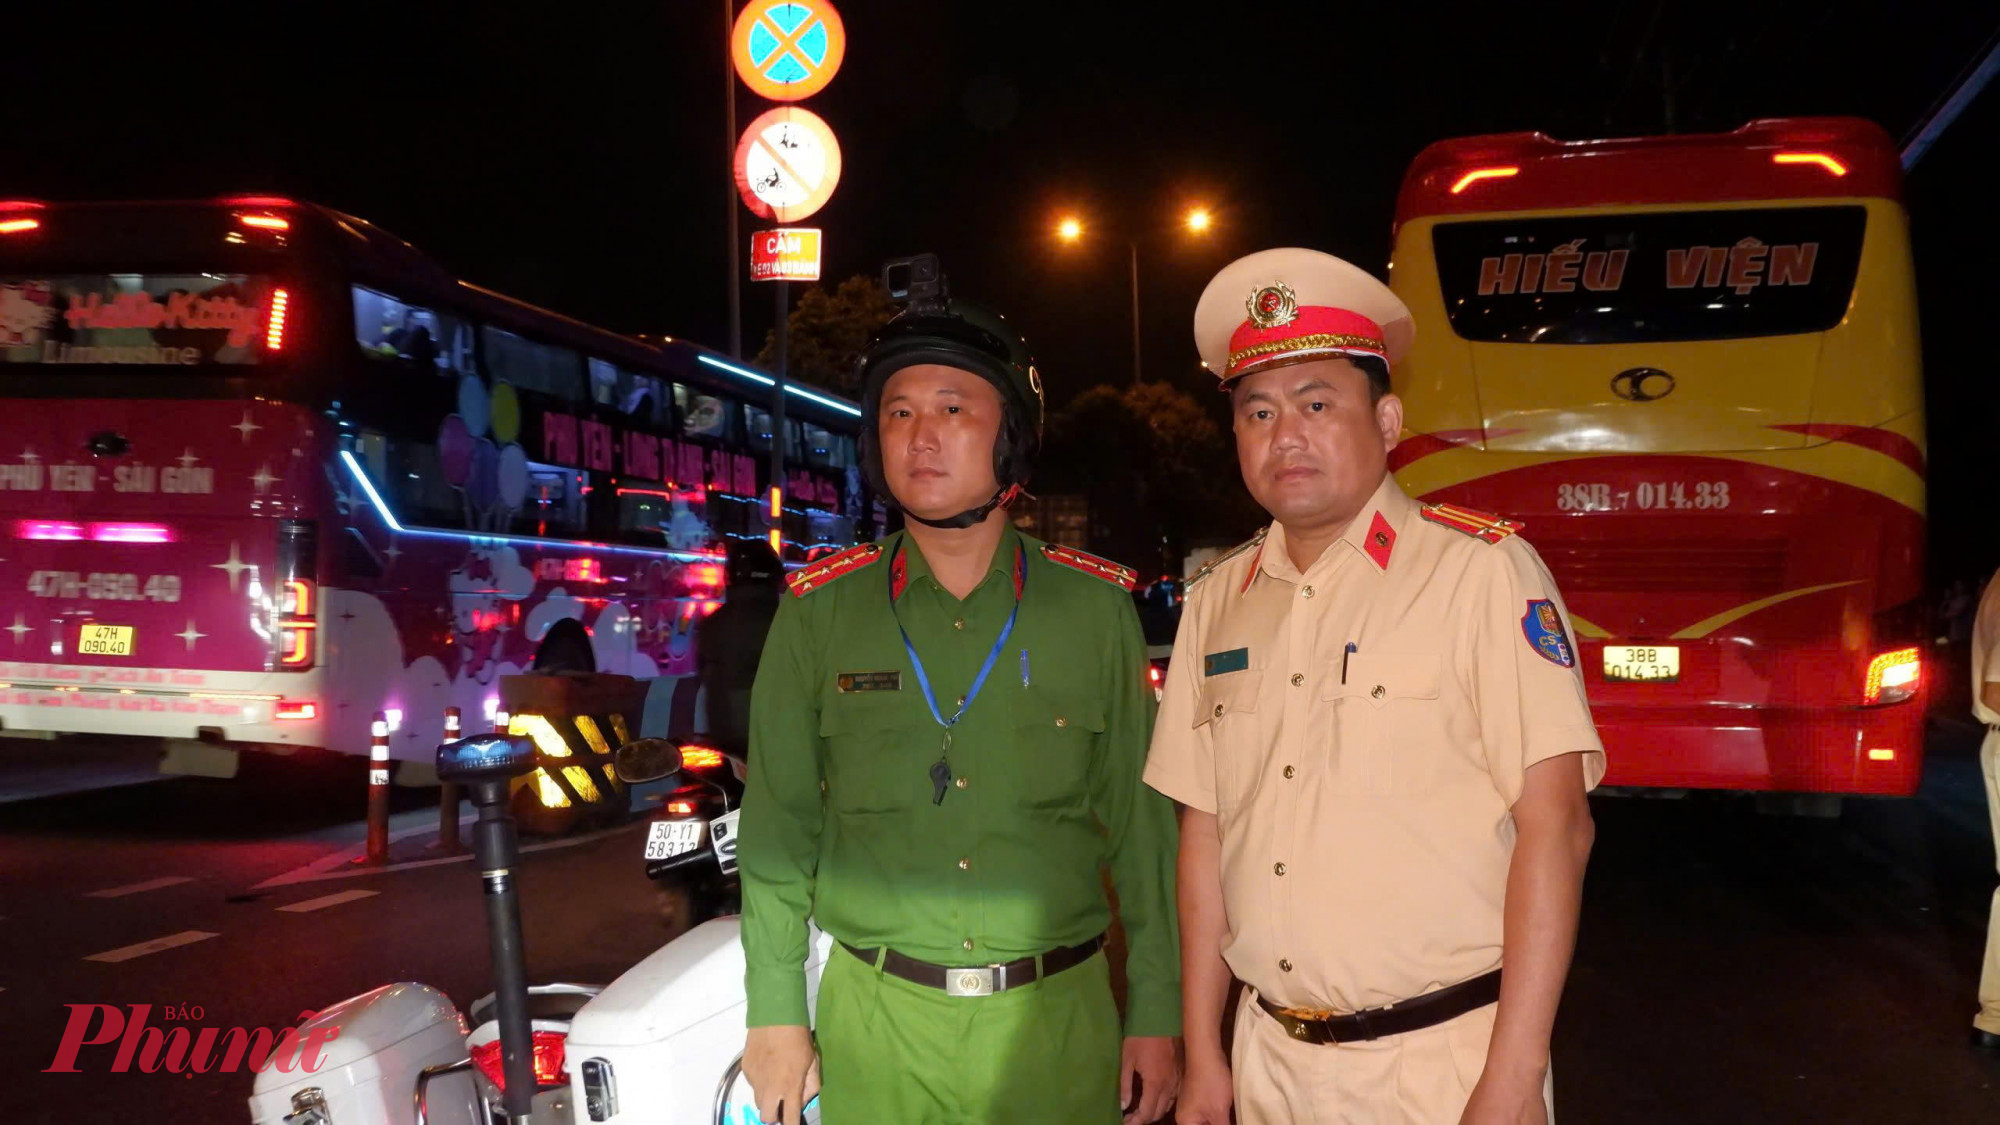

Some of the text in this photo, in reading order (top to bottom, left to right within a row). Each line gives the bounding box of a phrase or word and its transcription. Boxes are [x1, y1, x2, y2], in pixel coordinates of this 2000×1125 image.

[1478, 236, 1820, 296] HIẾU VIỆN
[1557, 483, 1611, 511] 38B
[1636, 481, 1731, 510] 014.33
[95, 627, 118, 640] 47H
[84, 641, 125, 653] 090.40
[1625, 648, 1657, 663] 38B
[656, 823, 693, 840] 50-Y1
